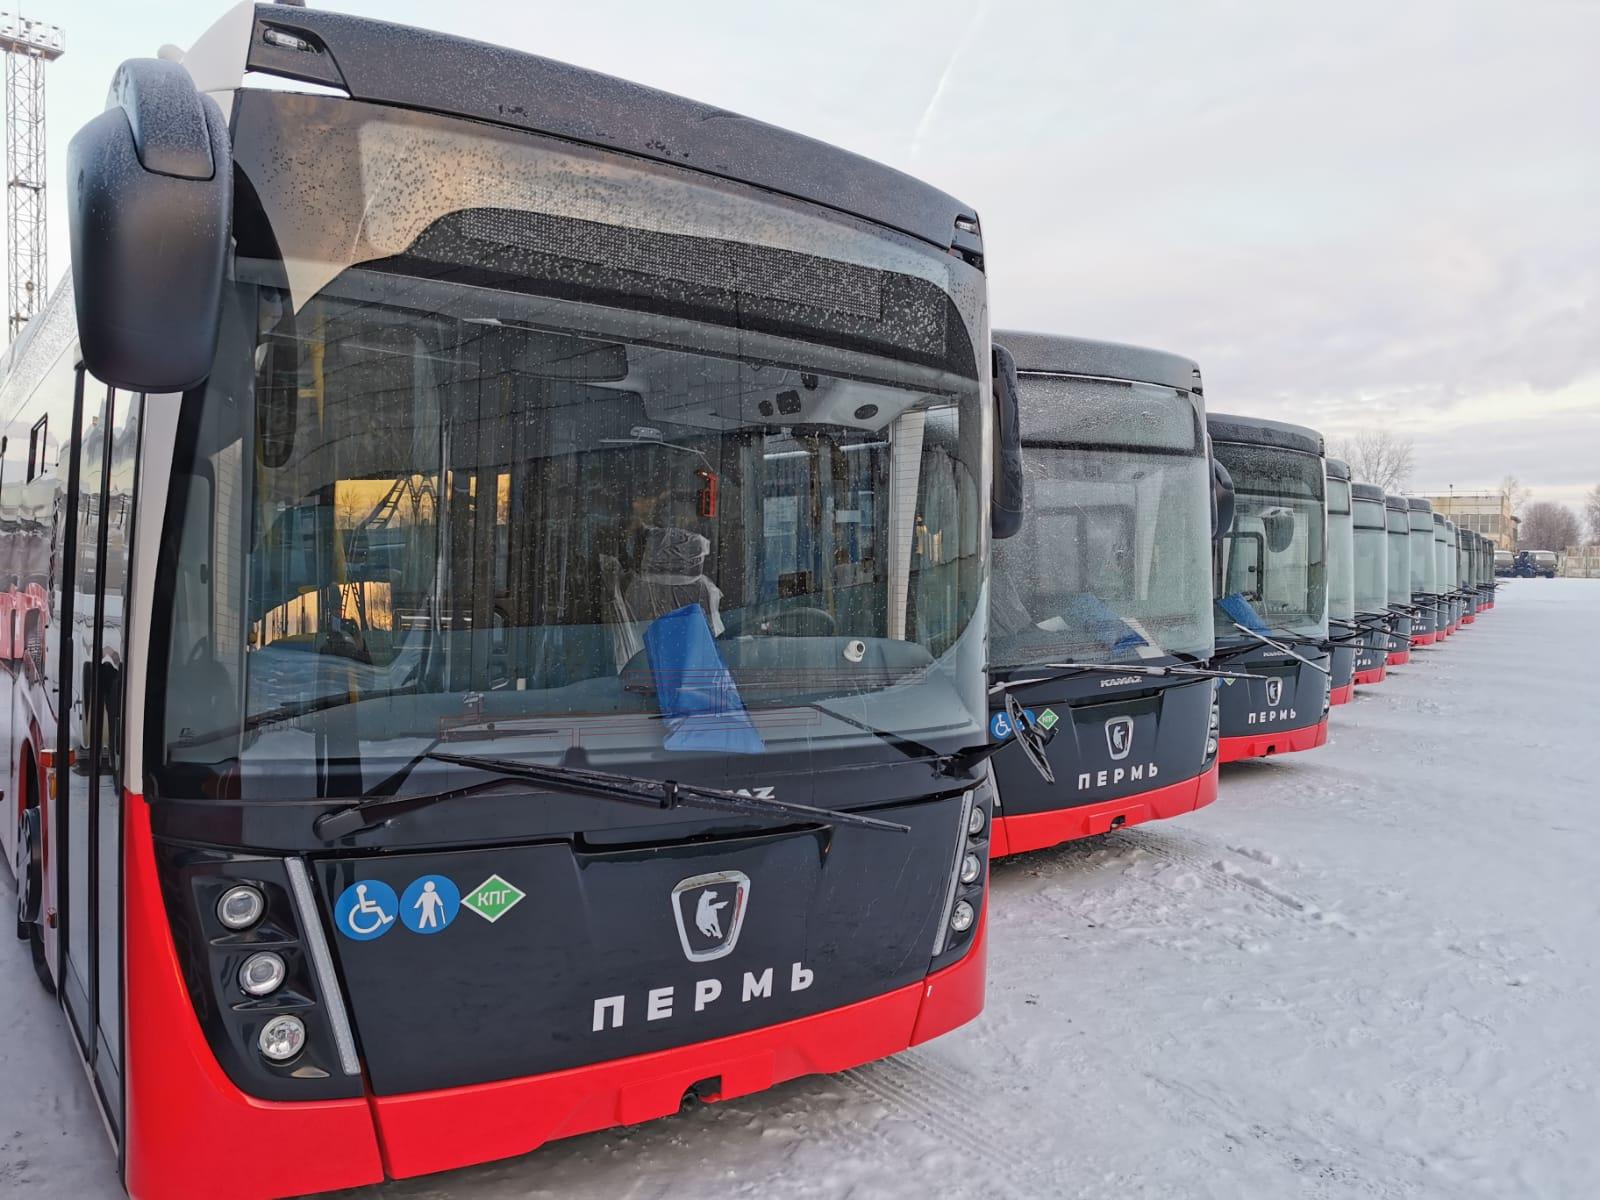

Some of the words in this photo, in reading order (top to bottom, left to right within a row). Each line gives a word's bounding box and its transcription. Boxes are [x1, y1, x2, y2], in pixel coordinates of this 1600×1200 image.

[1248, 708, 1296, 724] ПЕРМЬ
[1078, 762, 1158, 790] ПЕРМЬ
[477, 889, 511, 907] КПГ
[592, 961, 814, 1032] ПЕРМЬ
